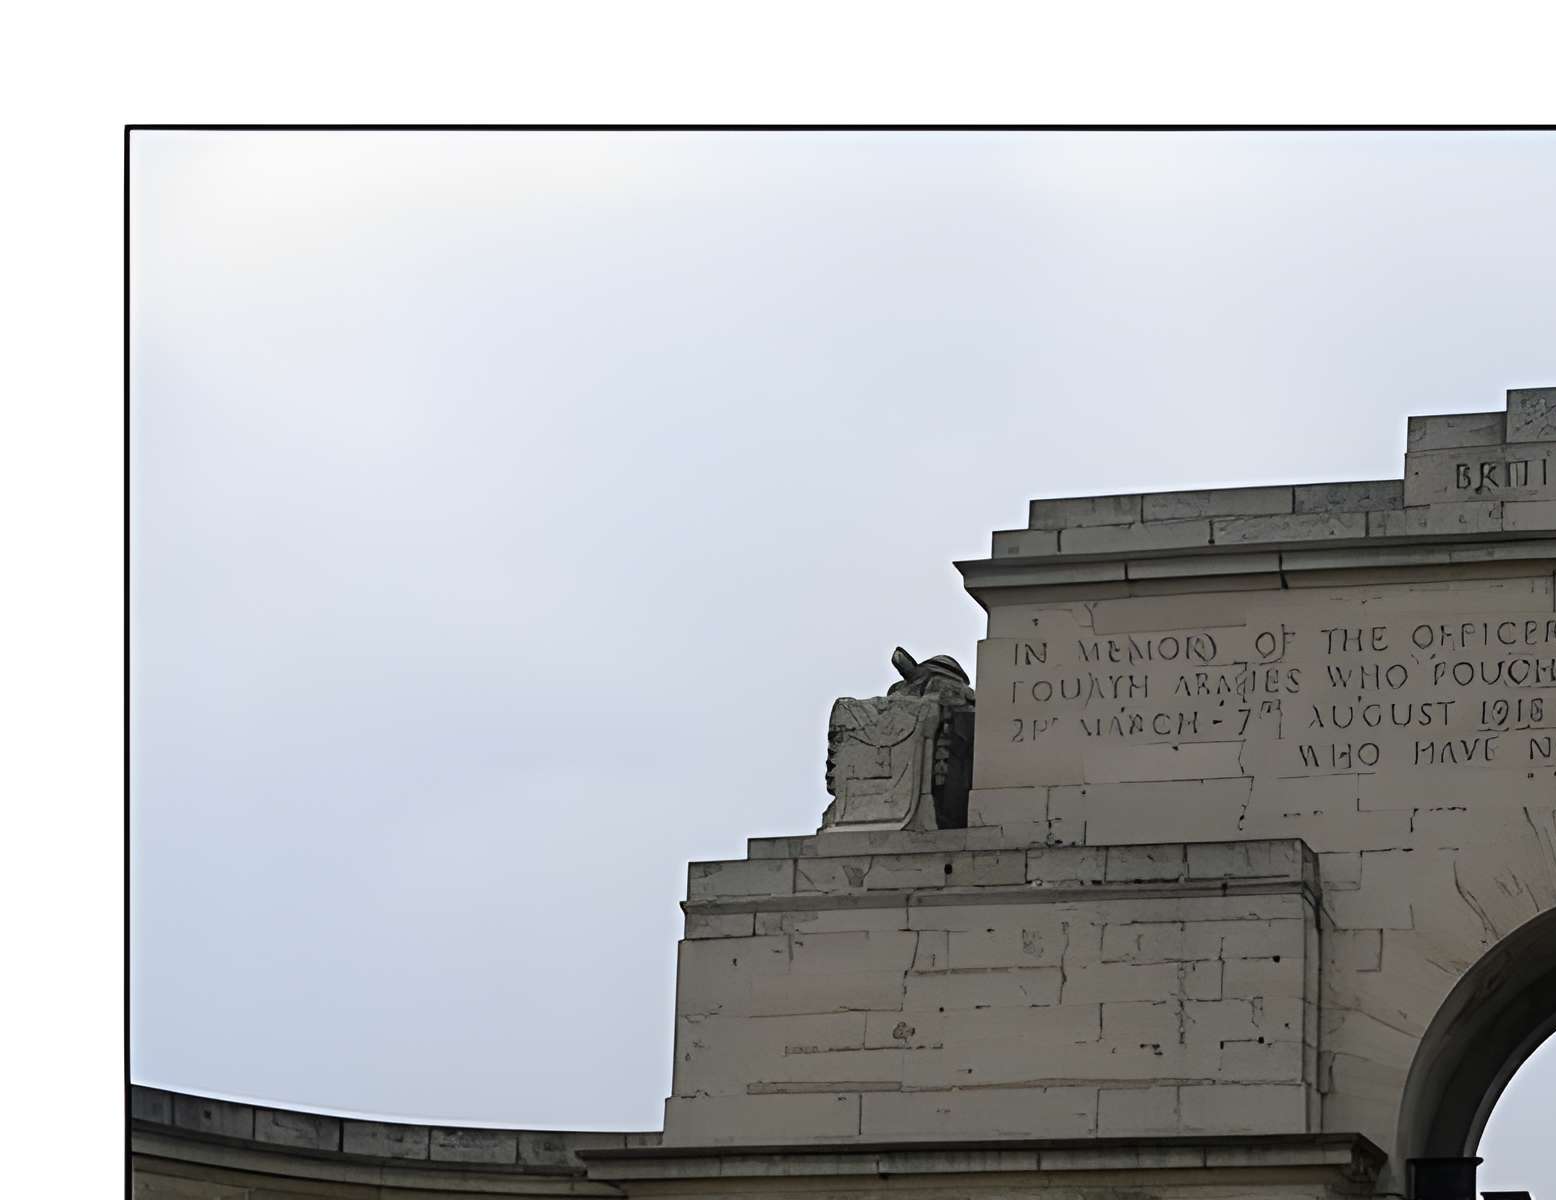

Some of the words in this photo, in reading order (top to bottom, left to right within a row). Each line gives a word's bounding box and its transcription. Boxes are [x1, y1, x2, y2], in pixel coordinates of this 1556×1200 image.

[1015, 642, 1047, 665] IN
[1321, 626, 1388, 654] THE
[1327, 664, 1408, 689] WHO
[1299, 742, 1380, 767] WHO
[1415, 737, 1498, 764] HAVE
